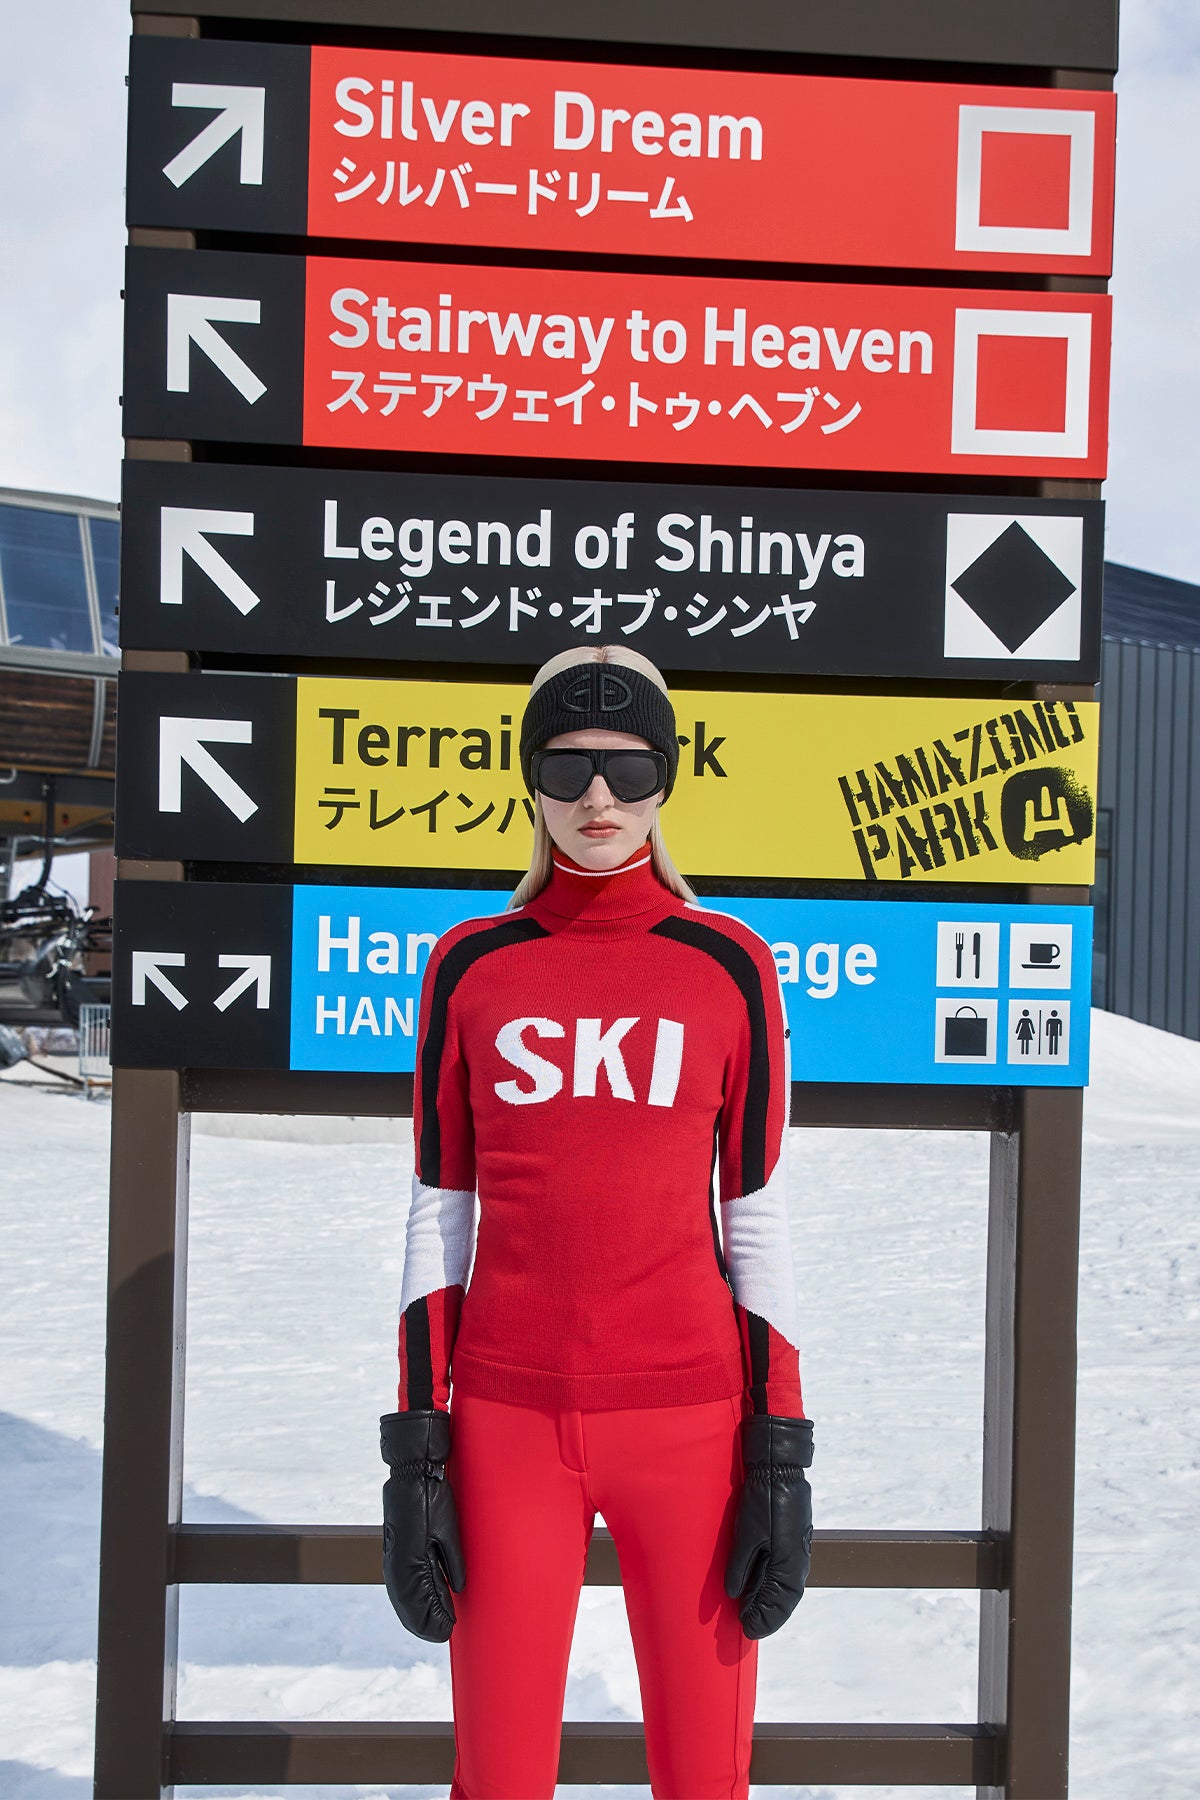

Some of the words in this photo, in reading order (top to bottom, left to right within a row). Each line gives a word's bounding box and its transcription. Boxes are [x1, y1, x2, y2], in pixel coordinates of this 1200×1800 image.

[333, 76, 531, 148] Silver
[553, 90, 763, 161] Dream
[332, 156, 694, 223] シルバードリーム
[328, 287, 616, 375] Stairway
[625, 309, 687, 364] to
[703, 306, 933, 375] Heaven
[326, 370, 862, 435] ステアウェイ・トゥ・ヘブン
[323, 499, 552, 578] Legend
[574, 512, 635, 570] of
[654, 513, 865, 591] Shinya
[325, 580, 817, 641] レジェンド・オブ・シンヤ
[318, 707, 512, 771] Terrai
[837, 701, 1085, 827] HANAZONO
[852, 790, 999, 880] PARK
[317, 915, 438, 975] Han
[770, 941, 878, 999] age
[315, 995, 414, 1037] HAN
[494, 1016, 685, 1108] SKI
